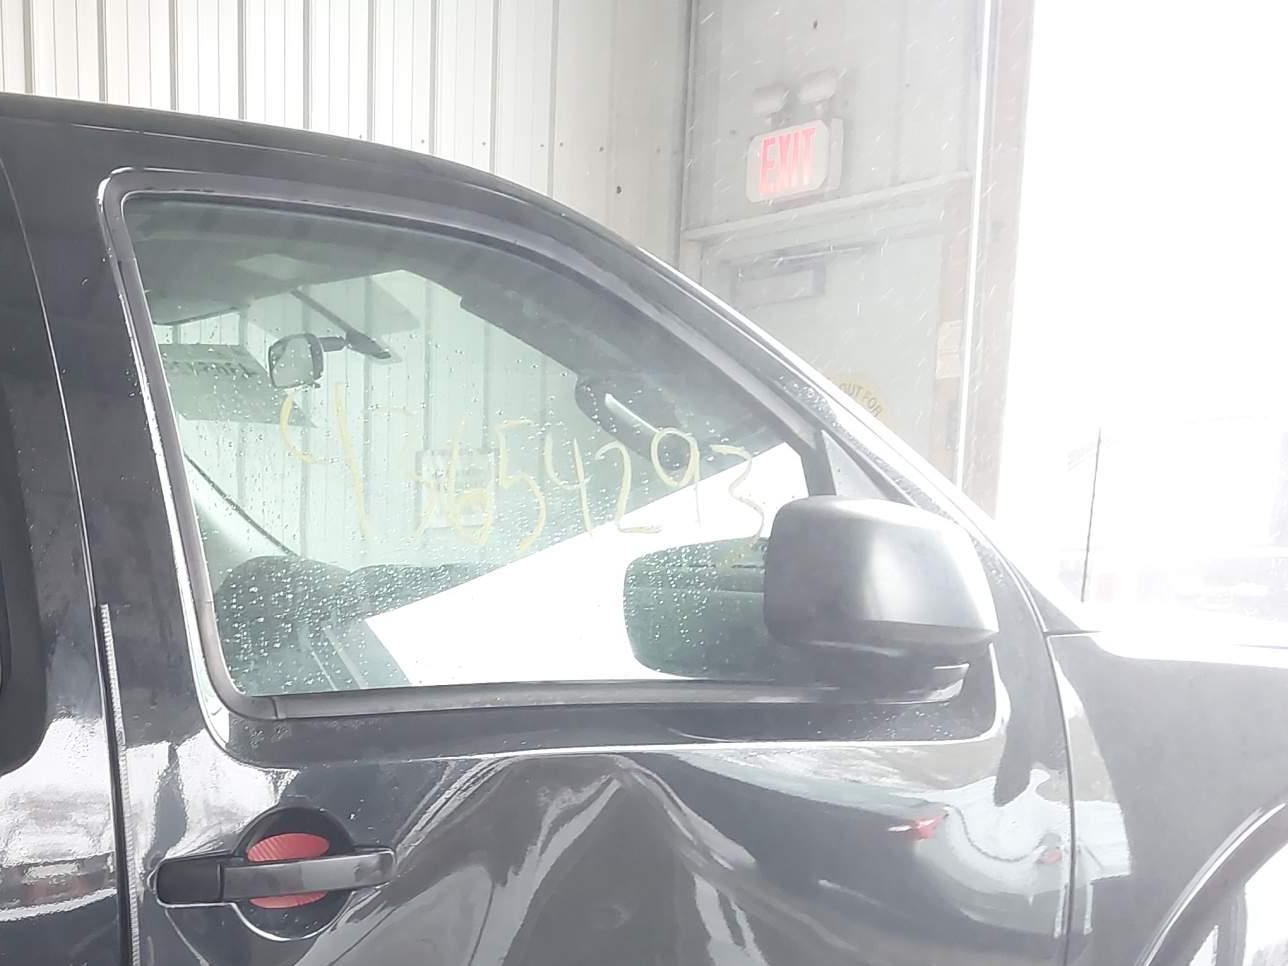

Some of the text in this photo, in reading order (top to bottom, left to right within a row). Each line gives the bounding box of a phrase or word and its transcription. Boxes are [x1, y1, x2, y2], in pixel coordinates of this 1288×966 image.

[759, 127, 817, 194] EXIT
[838, 383, 882, 418] OUT FOR
